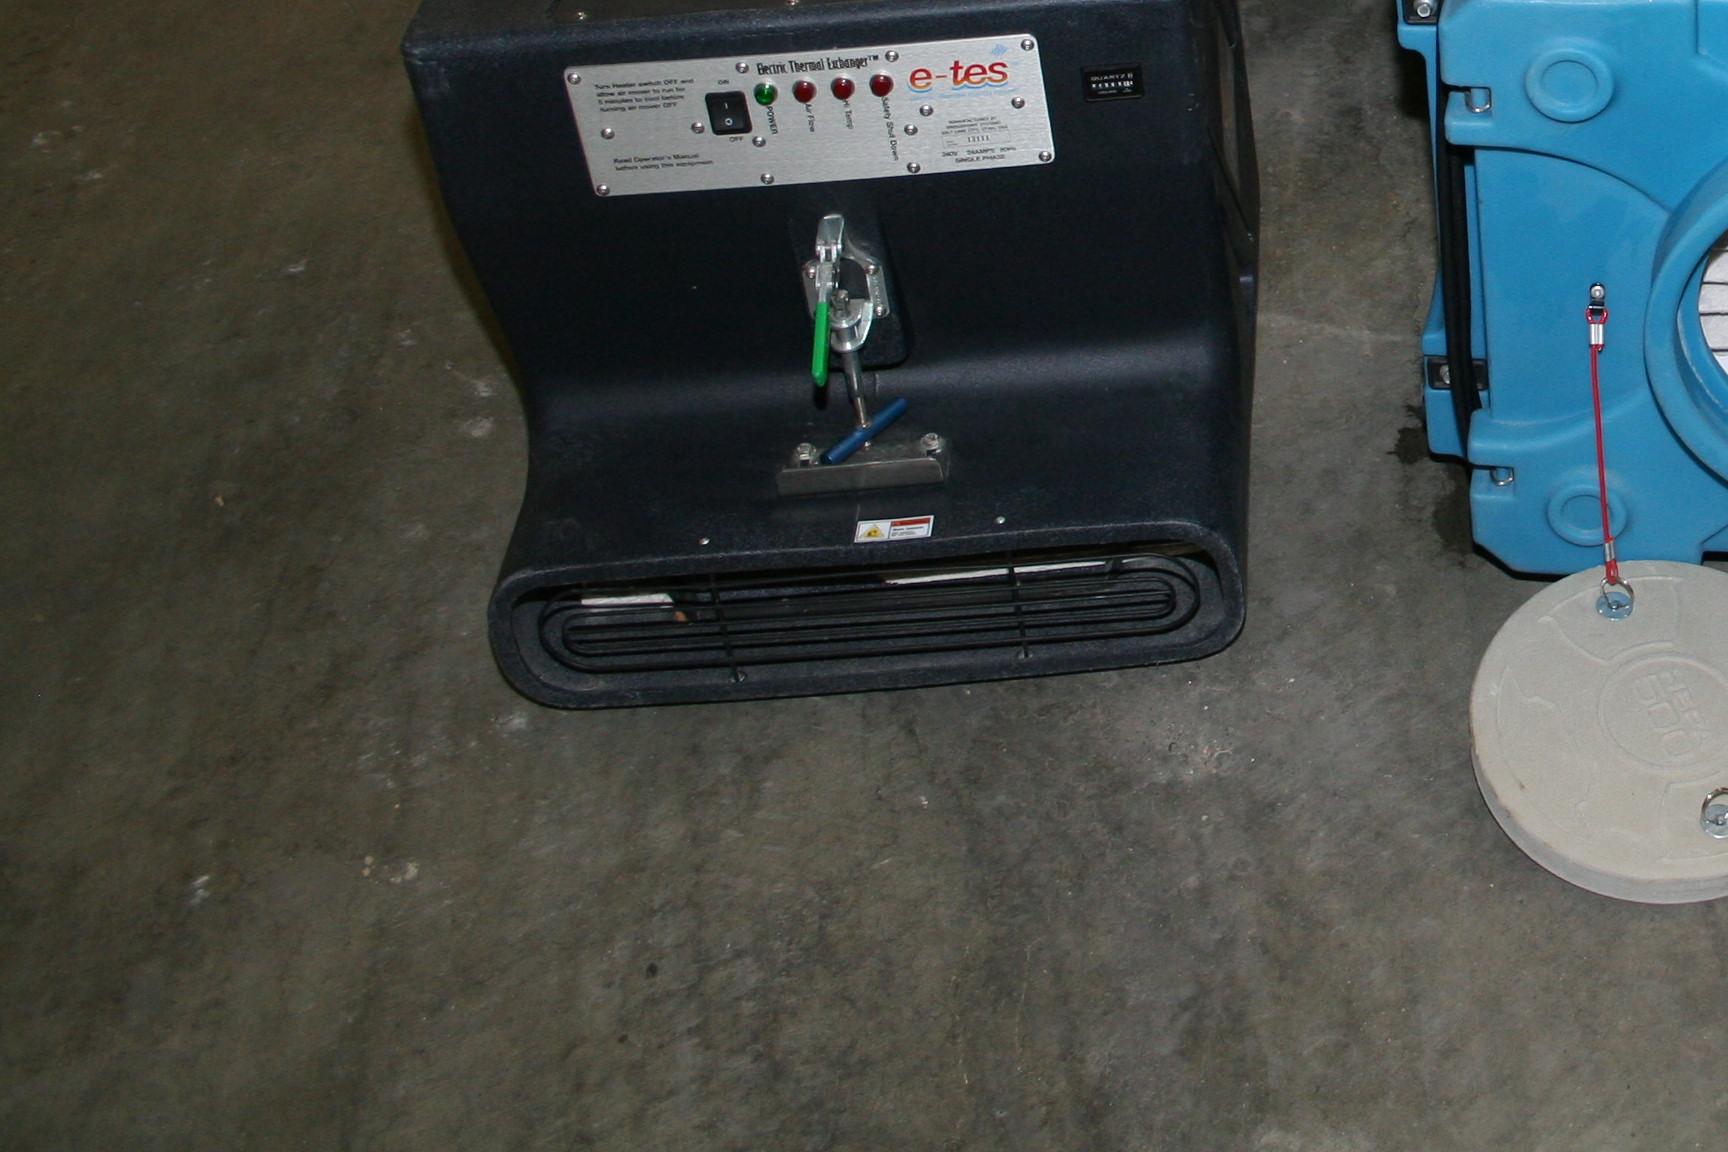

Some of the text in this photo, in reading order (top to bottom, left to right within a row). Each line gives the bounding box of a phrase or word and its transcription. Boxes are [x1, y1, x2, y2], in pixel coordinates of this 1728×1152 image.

[788, 58, 825, 74] Thermal
[909, 59, 1009, 90] e-tes
[766, 105, 779, 135] POWER
